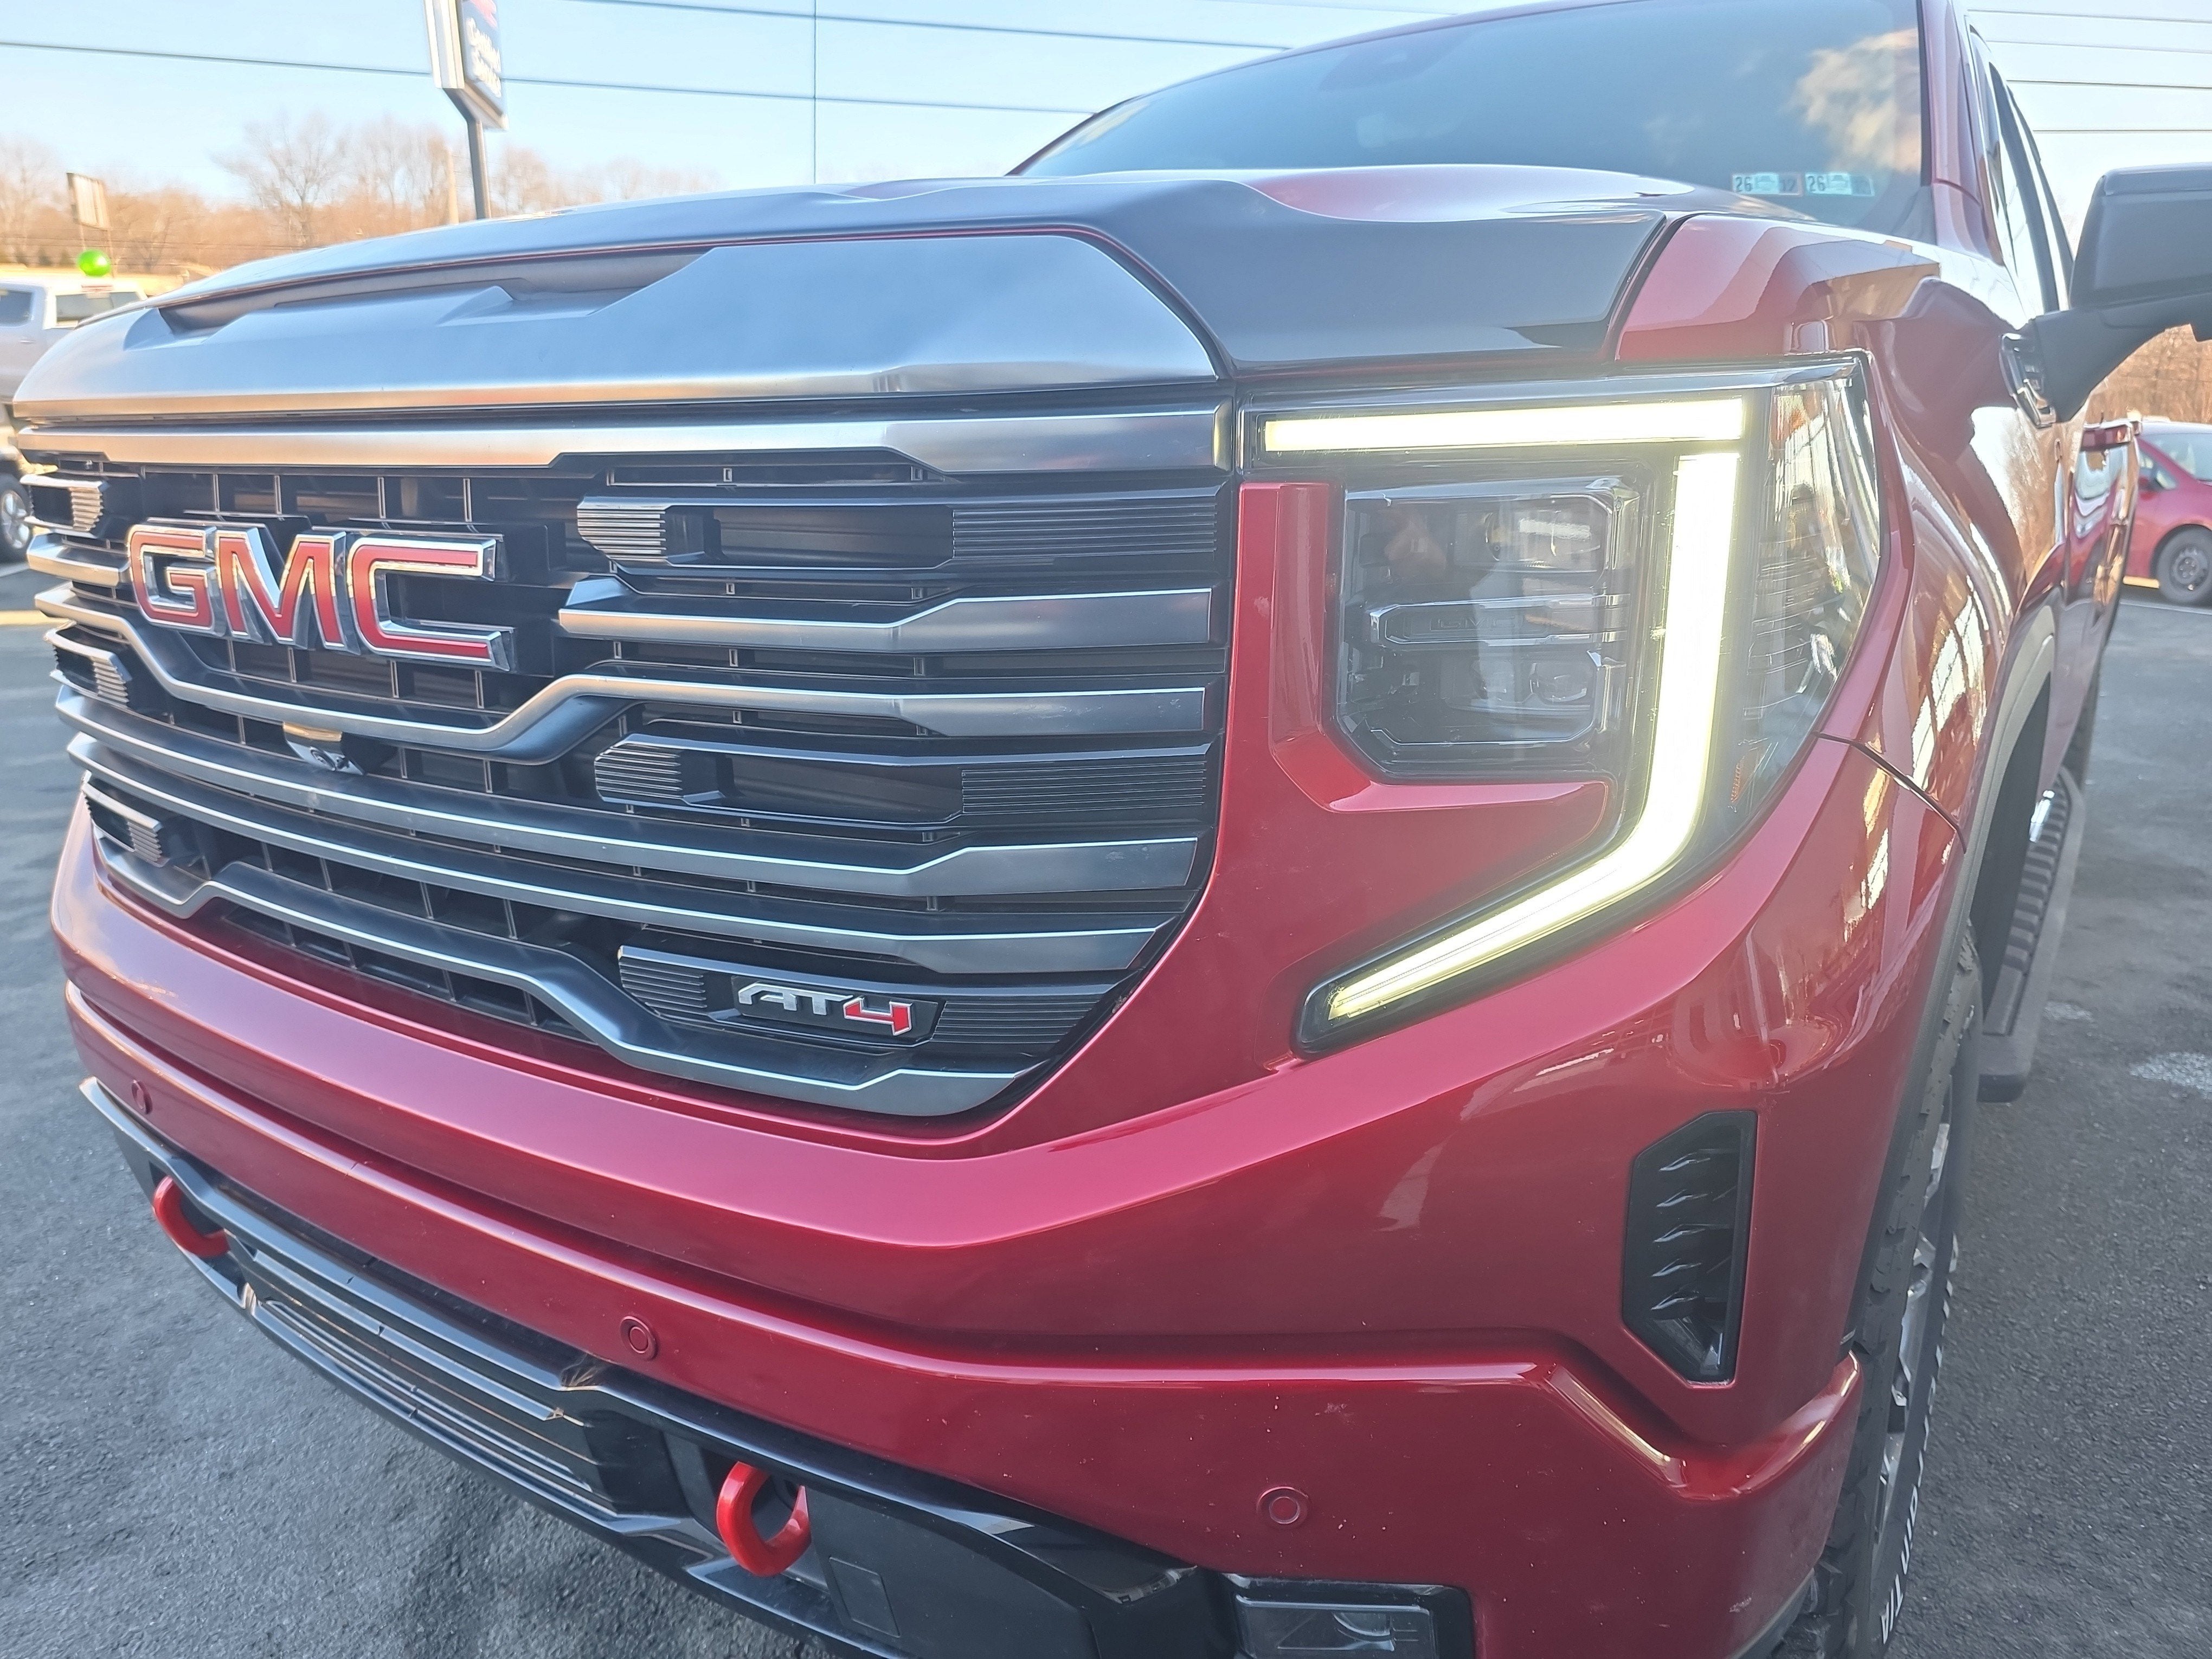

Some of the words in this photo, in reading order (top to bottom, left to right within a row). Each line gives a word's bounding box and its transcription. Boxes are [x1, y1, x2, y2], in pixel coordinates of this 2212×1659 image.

[1735, 176, 1753, 192] 26
[1807, 175, 1826, 192] 26
[127, 523, 511, 671] GMC
[1437, 615, 1516, 628] GMC
[738, 982, 913, 1036] AT4
